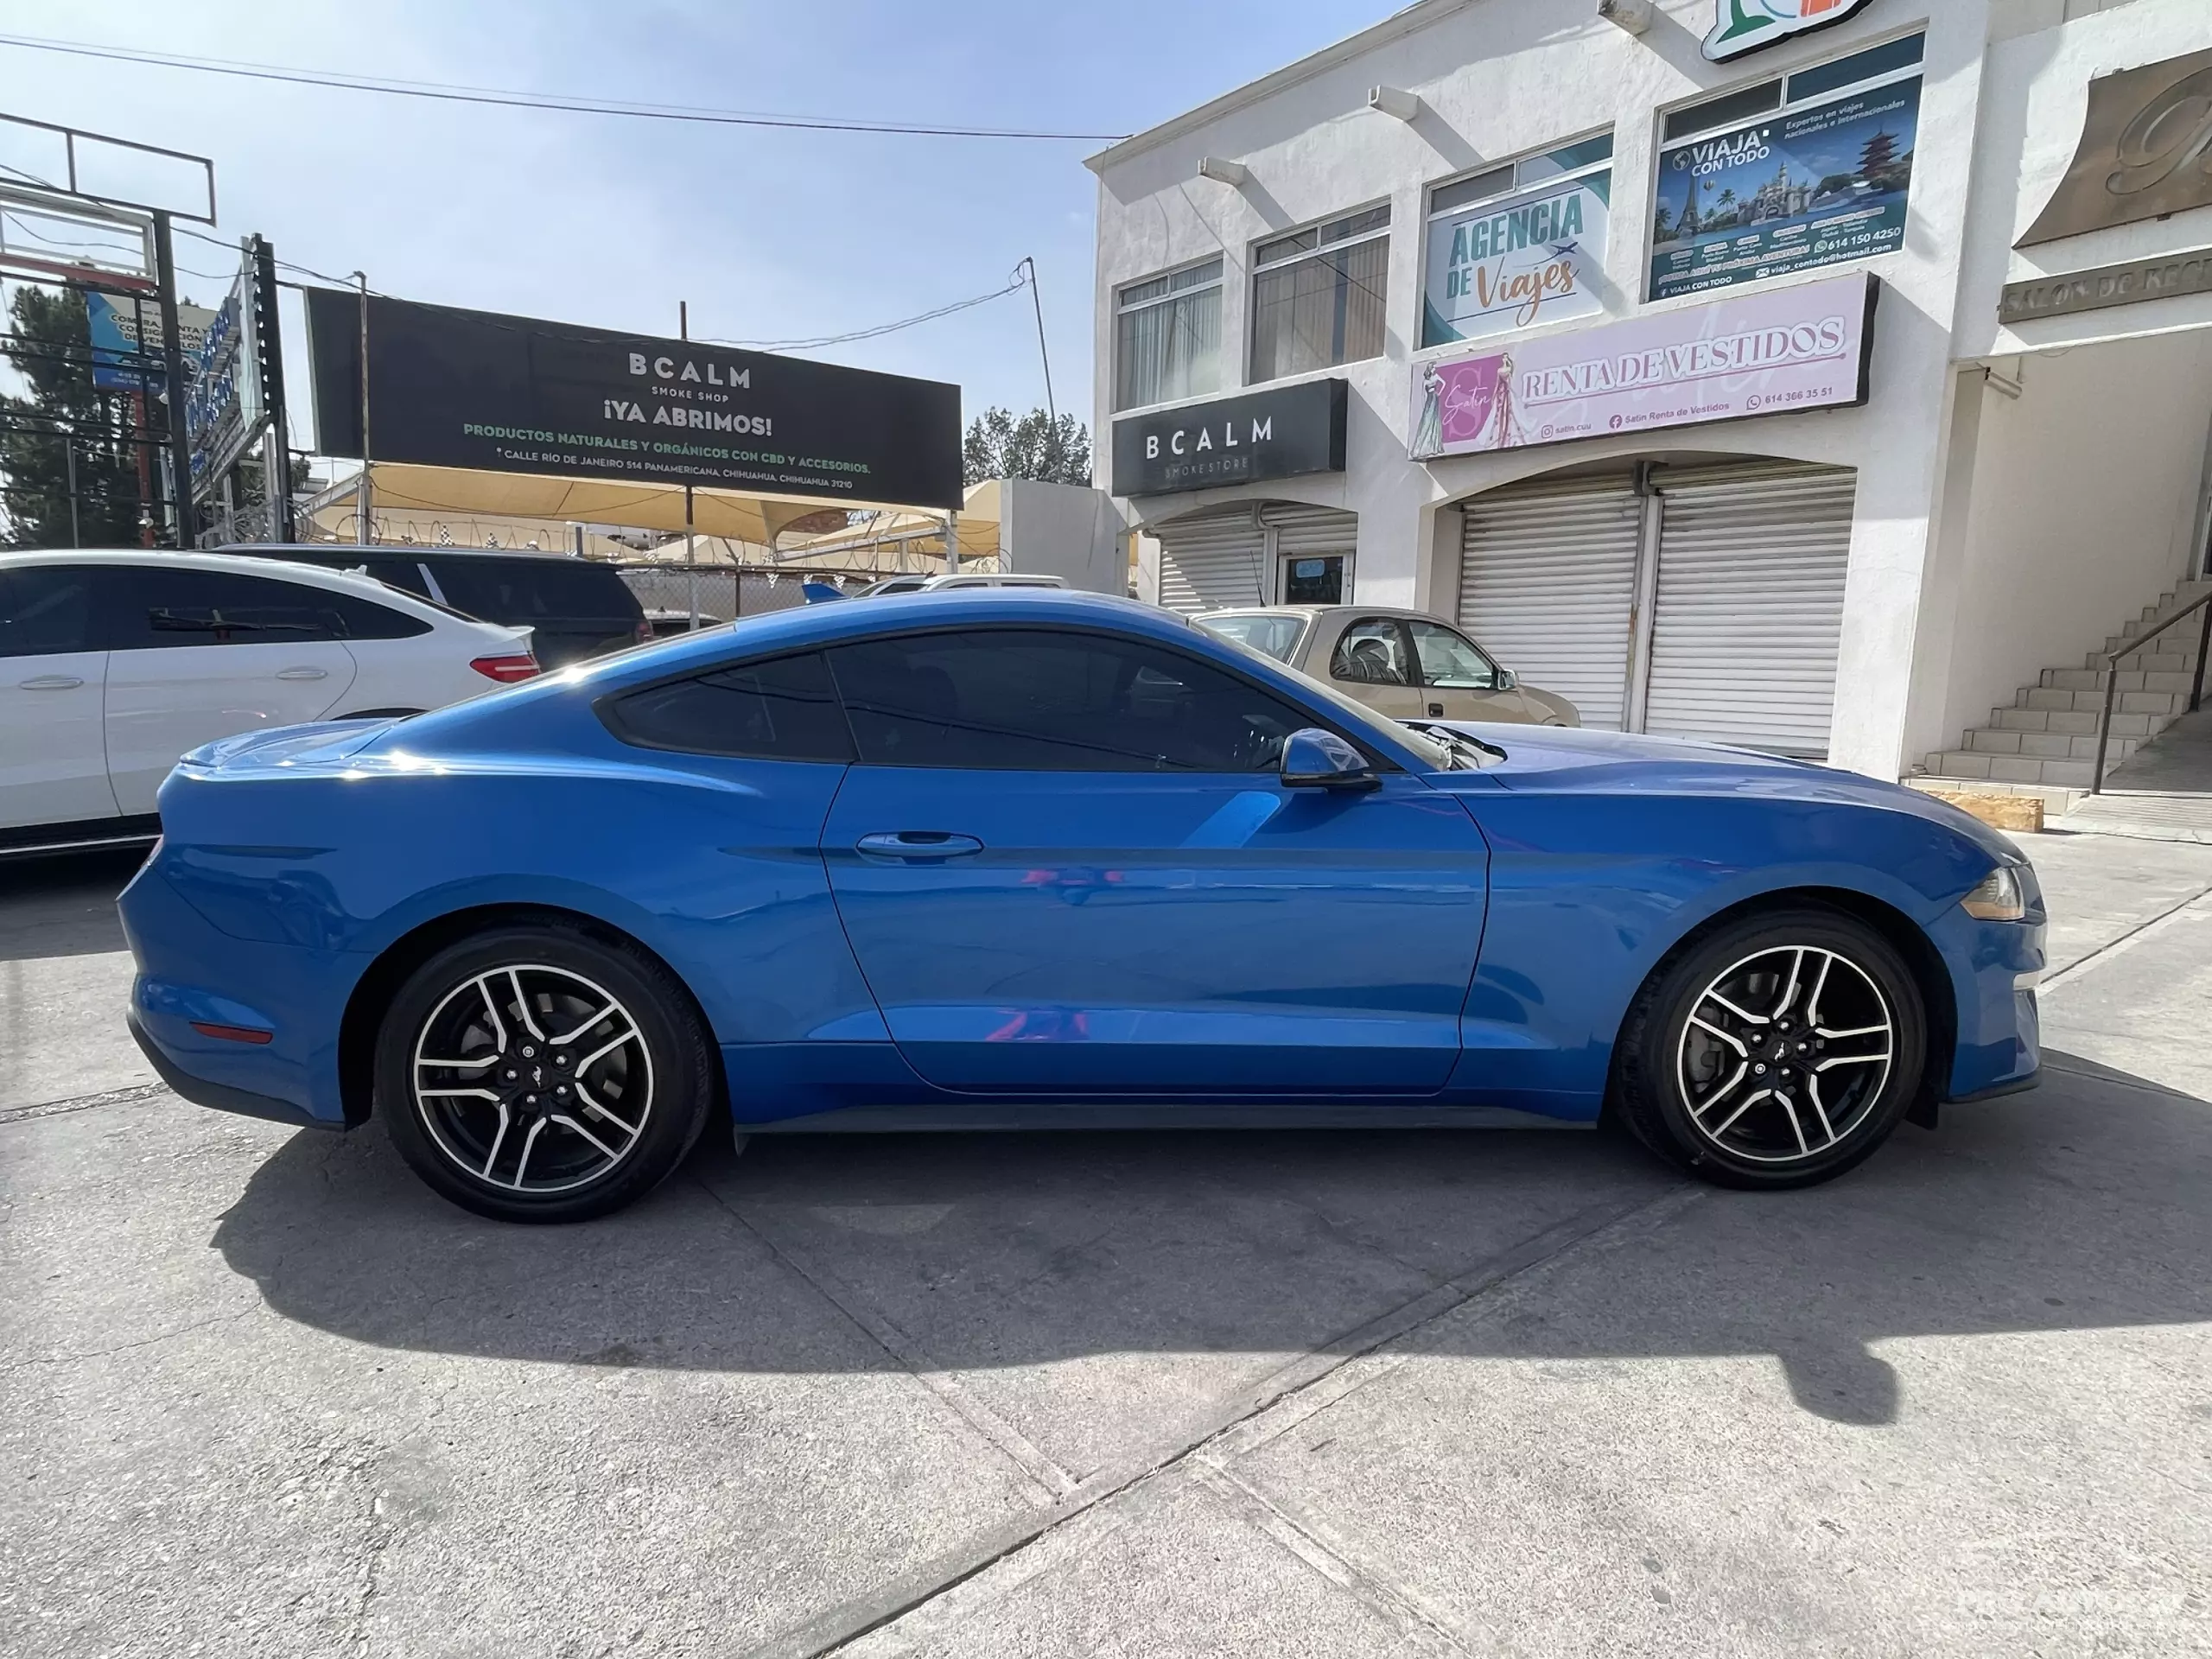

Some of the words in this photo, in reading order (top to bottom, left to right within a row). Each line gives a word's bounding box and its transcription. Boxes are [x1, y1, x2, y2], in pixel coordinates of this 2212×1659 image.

[1692, 130, 1761, 164] VIAJA
[1692, 158, 1724, 176] CON
[1726, 146, 1770, 168] TODO
[1449, 194, 1584, 268] AGENCIA
[1827, 237, 1848, 251] 614
[1851, 232, 1872, 245] 150
[1872, 226, 1902, 240] 4250
[1446, 267, 1472, 300] DE
[1477, 256, 1580, 327] Viajes
[1692, 281, 1710, 290] CON
[1710, 276, 1733, 287] TODO
[629, 353, 750, 389] BCALM
[1523, 359, 1614, 401] RENTA
[1618, 349, 1662, 385] DE
[1665, 317, 1845, 378] VESTIDOS
[652, 386, 692, 399] SMOKE
[698, 391, 729, 404] SHOP
[1649, 411, 1675, 421] Renta
[1676, 408, 1688, 416] de
[1690, 403, 1730, 415] Vestidos
[1764, 395, 1783, 404] 614
[1806, 389, 1818, 398] 35
[1821, 387, 1834, 397] 51
[604, 399, 646, 423] ¡YA
[652, 405, 772, 436] ABRIMOS!
[464, 423, 555, 443] PRODUCTOS
[558, 433, 638, 451] NATURALES
[641, 441, 650, 451] Y
[653, 442, 729, 460] ORGÁNICOS
[732, 449, 759, 462] CON
[761, 453, 785, 465] CBD
[788, 456, 797, 467] Y
[798, 457, 871, 474] ACCESORIOS.
[1146, 416, 1273, 461] BCALM
[505, 449, 538, 461] CALLE
[542, 451, 562, 463] RÍO
[563, 455, 578, 466] DE
[581, 456, 624, 468] JANEIRO
[626, 461, 642, 470] 514
[645, 462, 721, 478] PANAMERICANA,
[723, 469, 778, 483] CHIHUAHUA,
[779, 474, 830, 488] CHIHUAHUA
[831, 480, 853, 489] 31210
[1208, 456, 1249, 474] STORE
